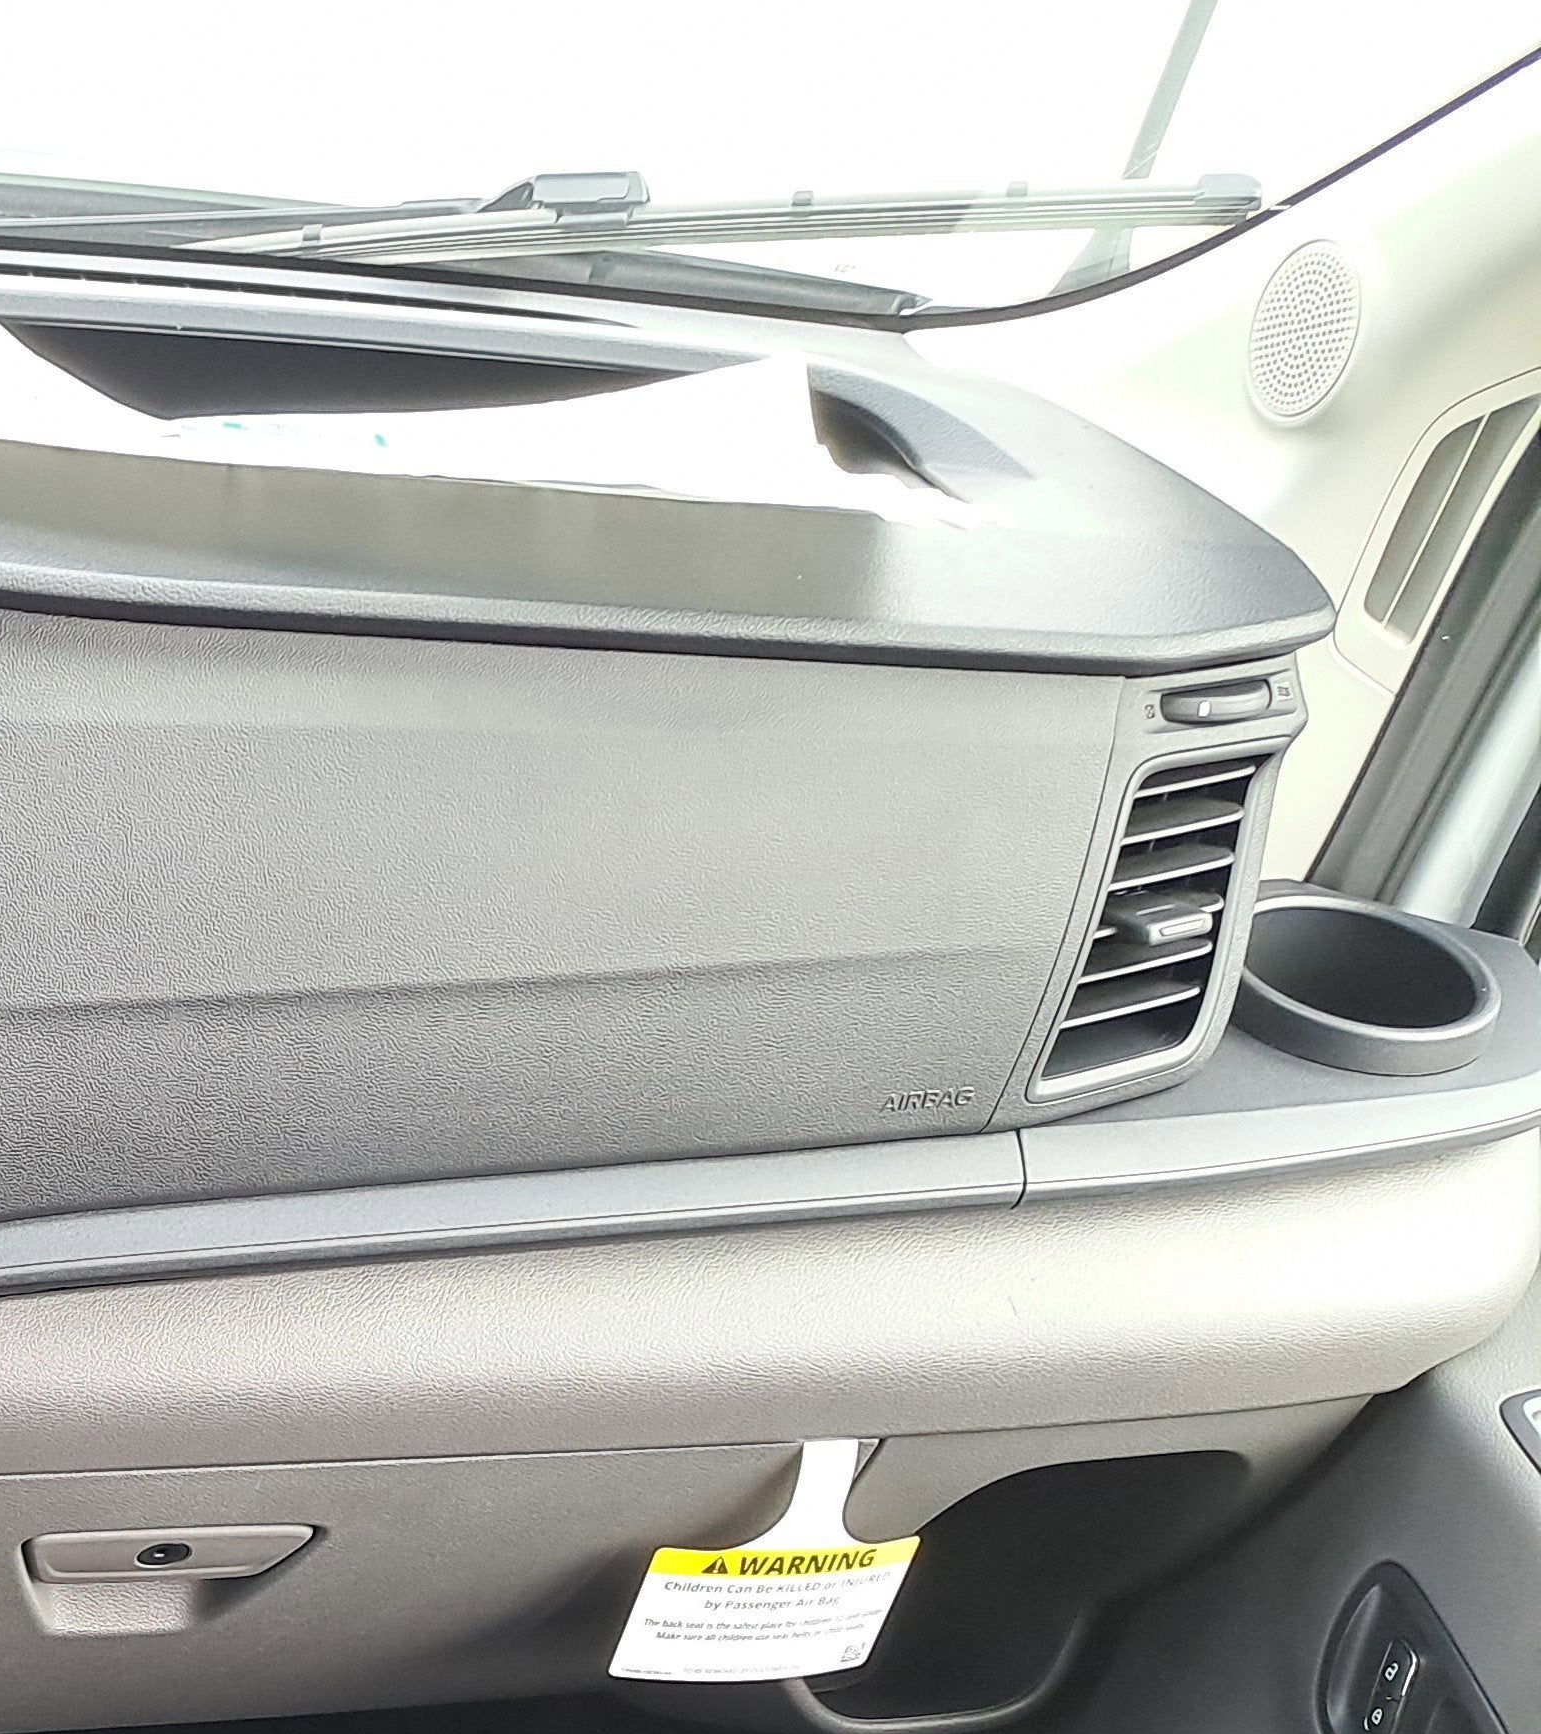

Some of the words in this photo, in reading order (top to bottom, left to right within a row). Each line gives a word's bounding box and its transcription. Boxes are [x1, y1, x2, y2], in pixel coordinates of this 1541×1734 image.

[879, 1083, 976, 1113] AIRBAG
[738, 1548, 878, 1576] WARNING
[664, 1581, 723, 1594] Children
[726, 1584, 752, 1594] Can
[755, 1583, 774, 1594] Be
[776, 1582, 821, 1593] KILLED
[824, 1582, 836, 1590] or
[704, 1600, 722, 1611] by
[724, 1600, 793, 1611] Passenger
[795, 1598, 813, 1607] Air
